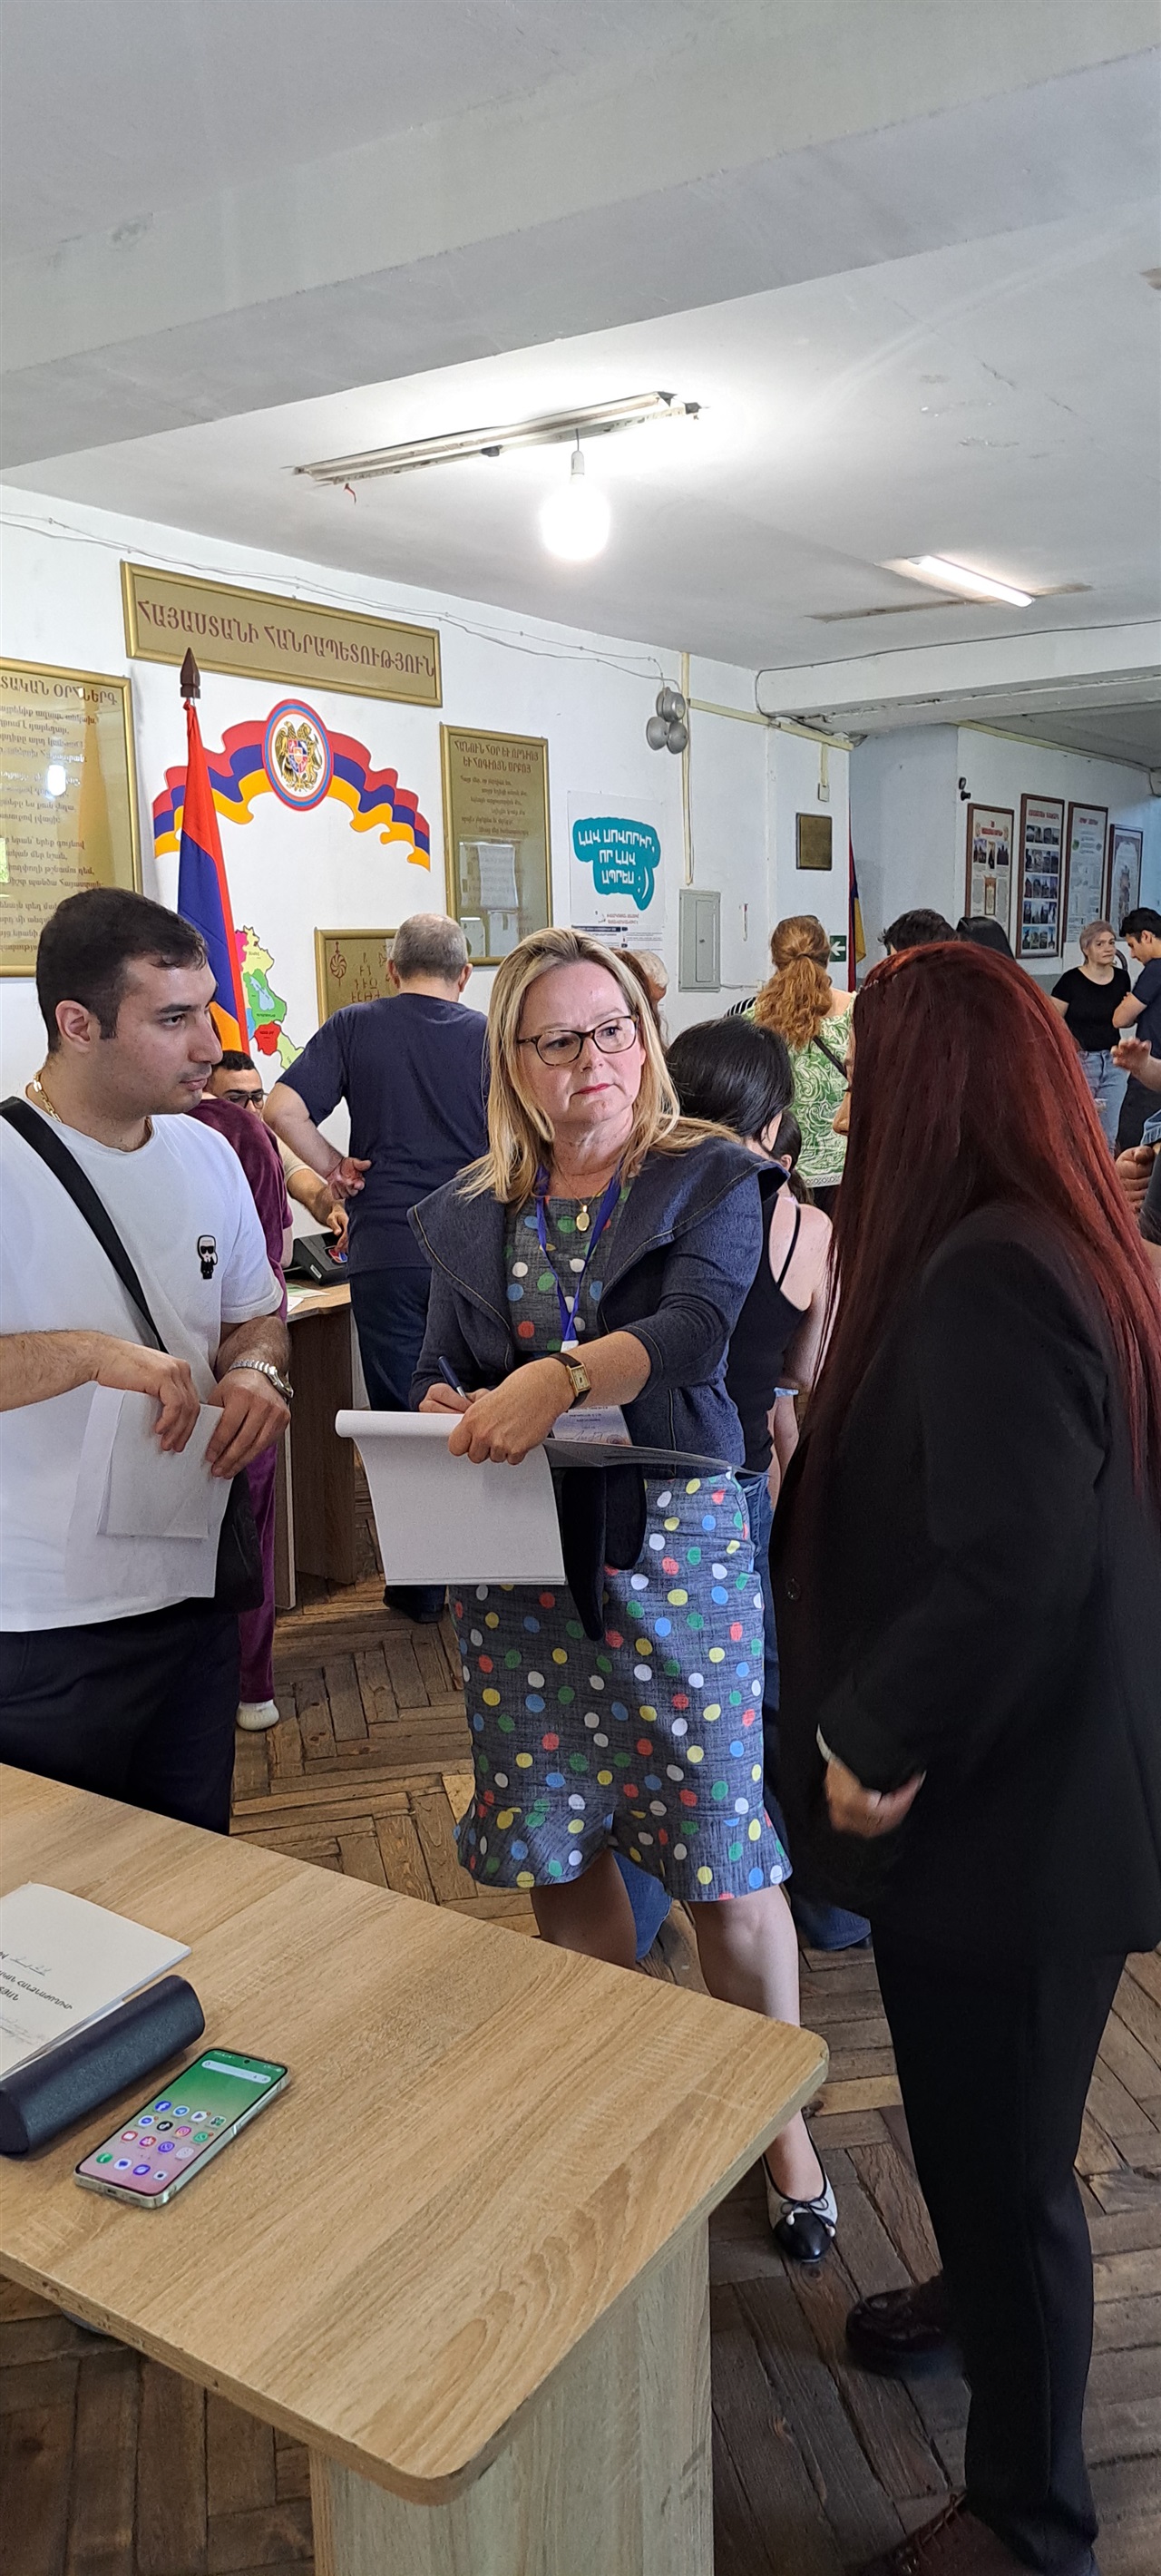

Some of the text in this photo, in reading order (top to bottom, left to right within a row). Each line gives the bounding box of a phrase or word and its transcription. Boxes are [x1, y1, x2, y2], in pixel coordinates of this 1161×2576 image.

[138, 600, 435, 678] ՀԱՅԱՍՏԱՆԻ ՀԱՆՐԱՊԵՏՈՒԹՅՈՒՆ
[0, 675, 49, 696] ՏԱԿԱՆ
[578, 829, 600, 846] ԼԱՎ
[599, 849, 636, 865] ՈՐ ԼԱՎ
[601, 869, 634, 884] ԱՊՐԵՍ
